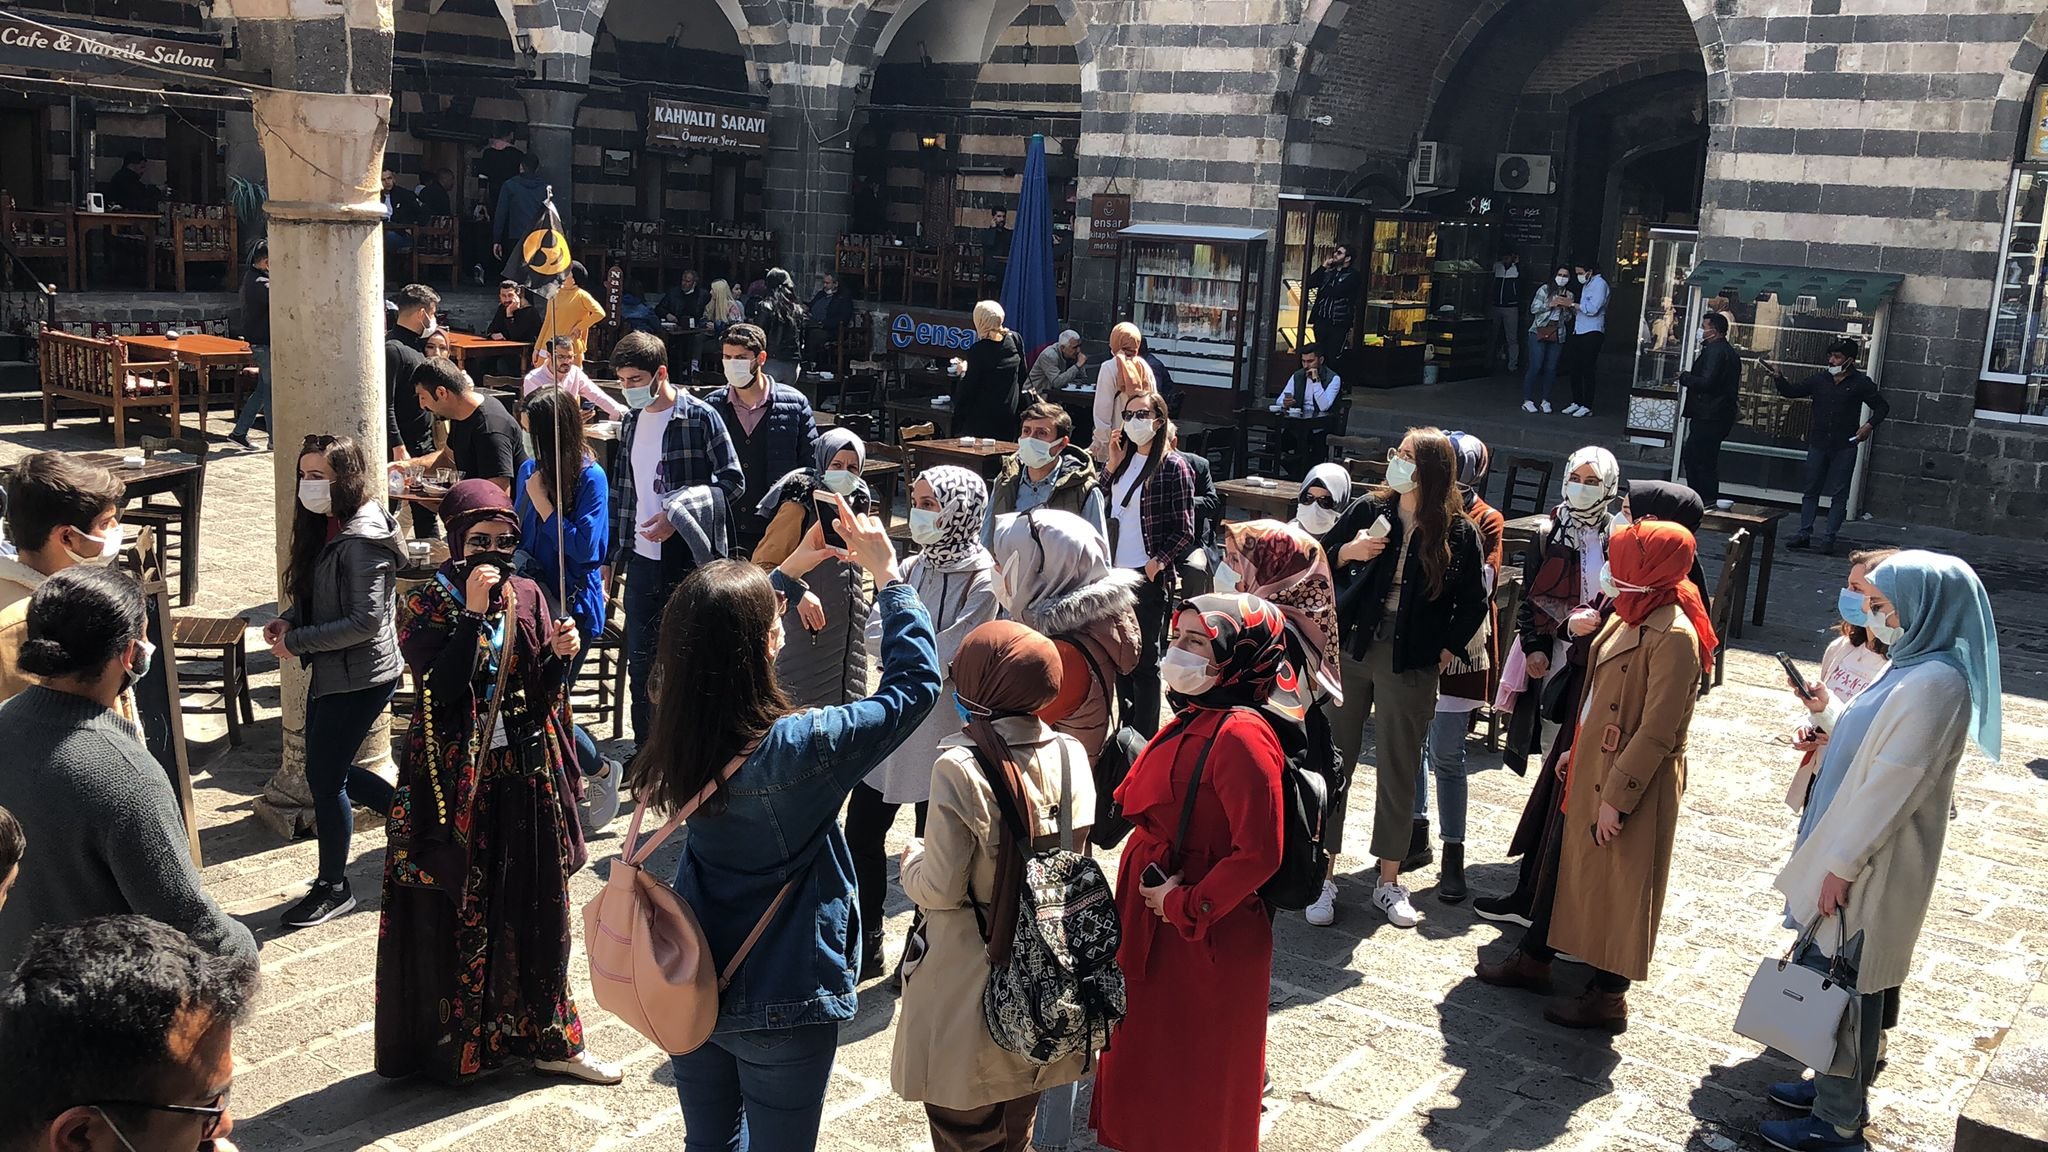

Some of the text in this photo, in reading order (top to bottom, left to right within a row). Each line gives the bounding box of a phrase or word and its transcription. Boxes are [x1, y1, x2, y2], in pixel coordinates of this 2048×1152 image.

[1, 26, 216, 69] Cafe & Nargile Salonu
[654, 106, 766, 134] KAHVALTI SARAYI
[681, 128, 718, 144] Ömer'in
[1093, 219, 1122, 228] ensar
[915, 322, 978, 350] ensa
